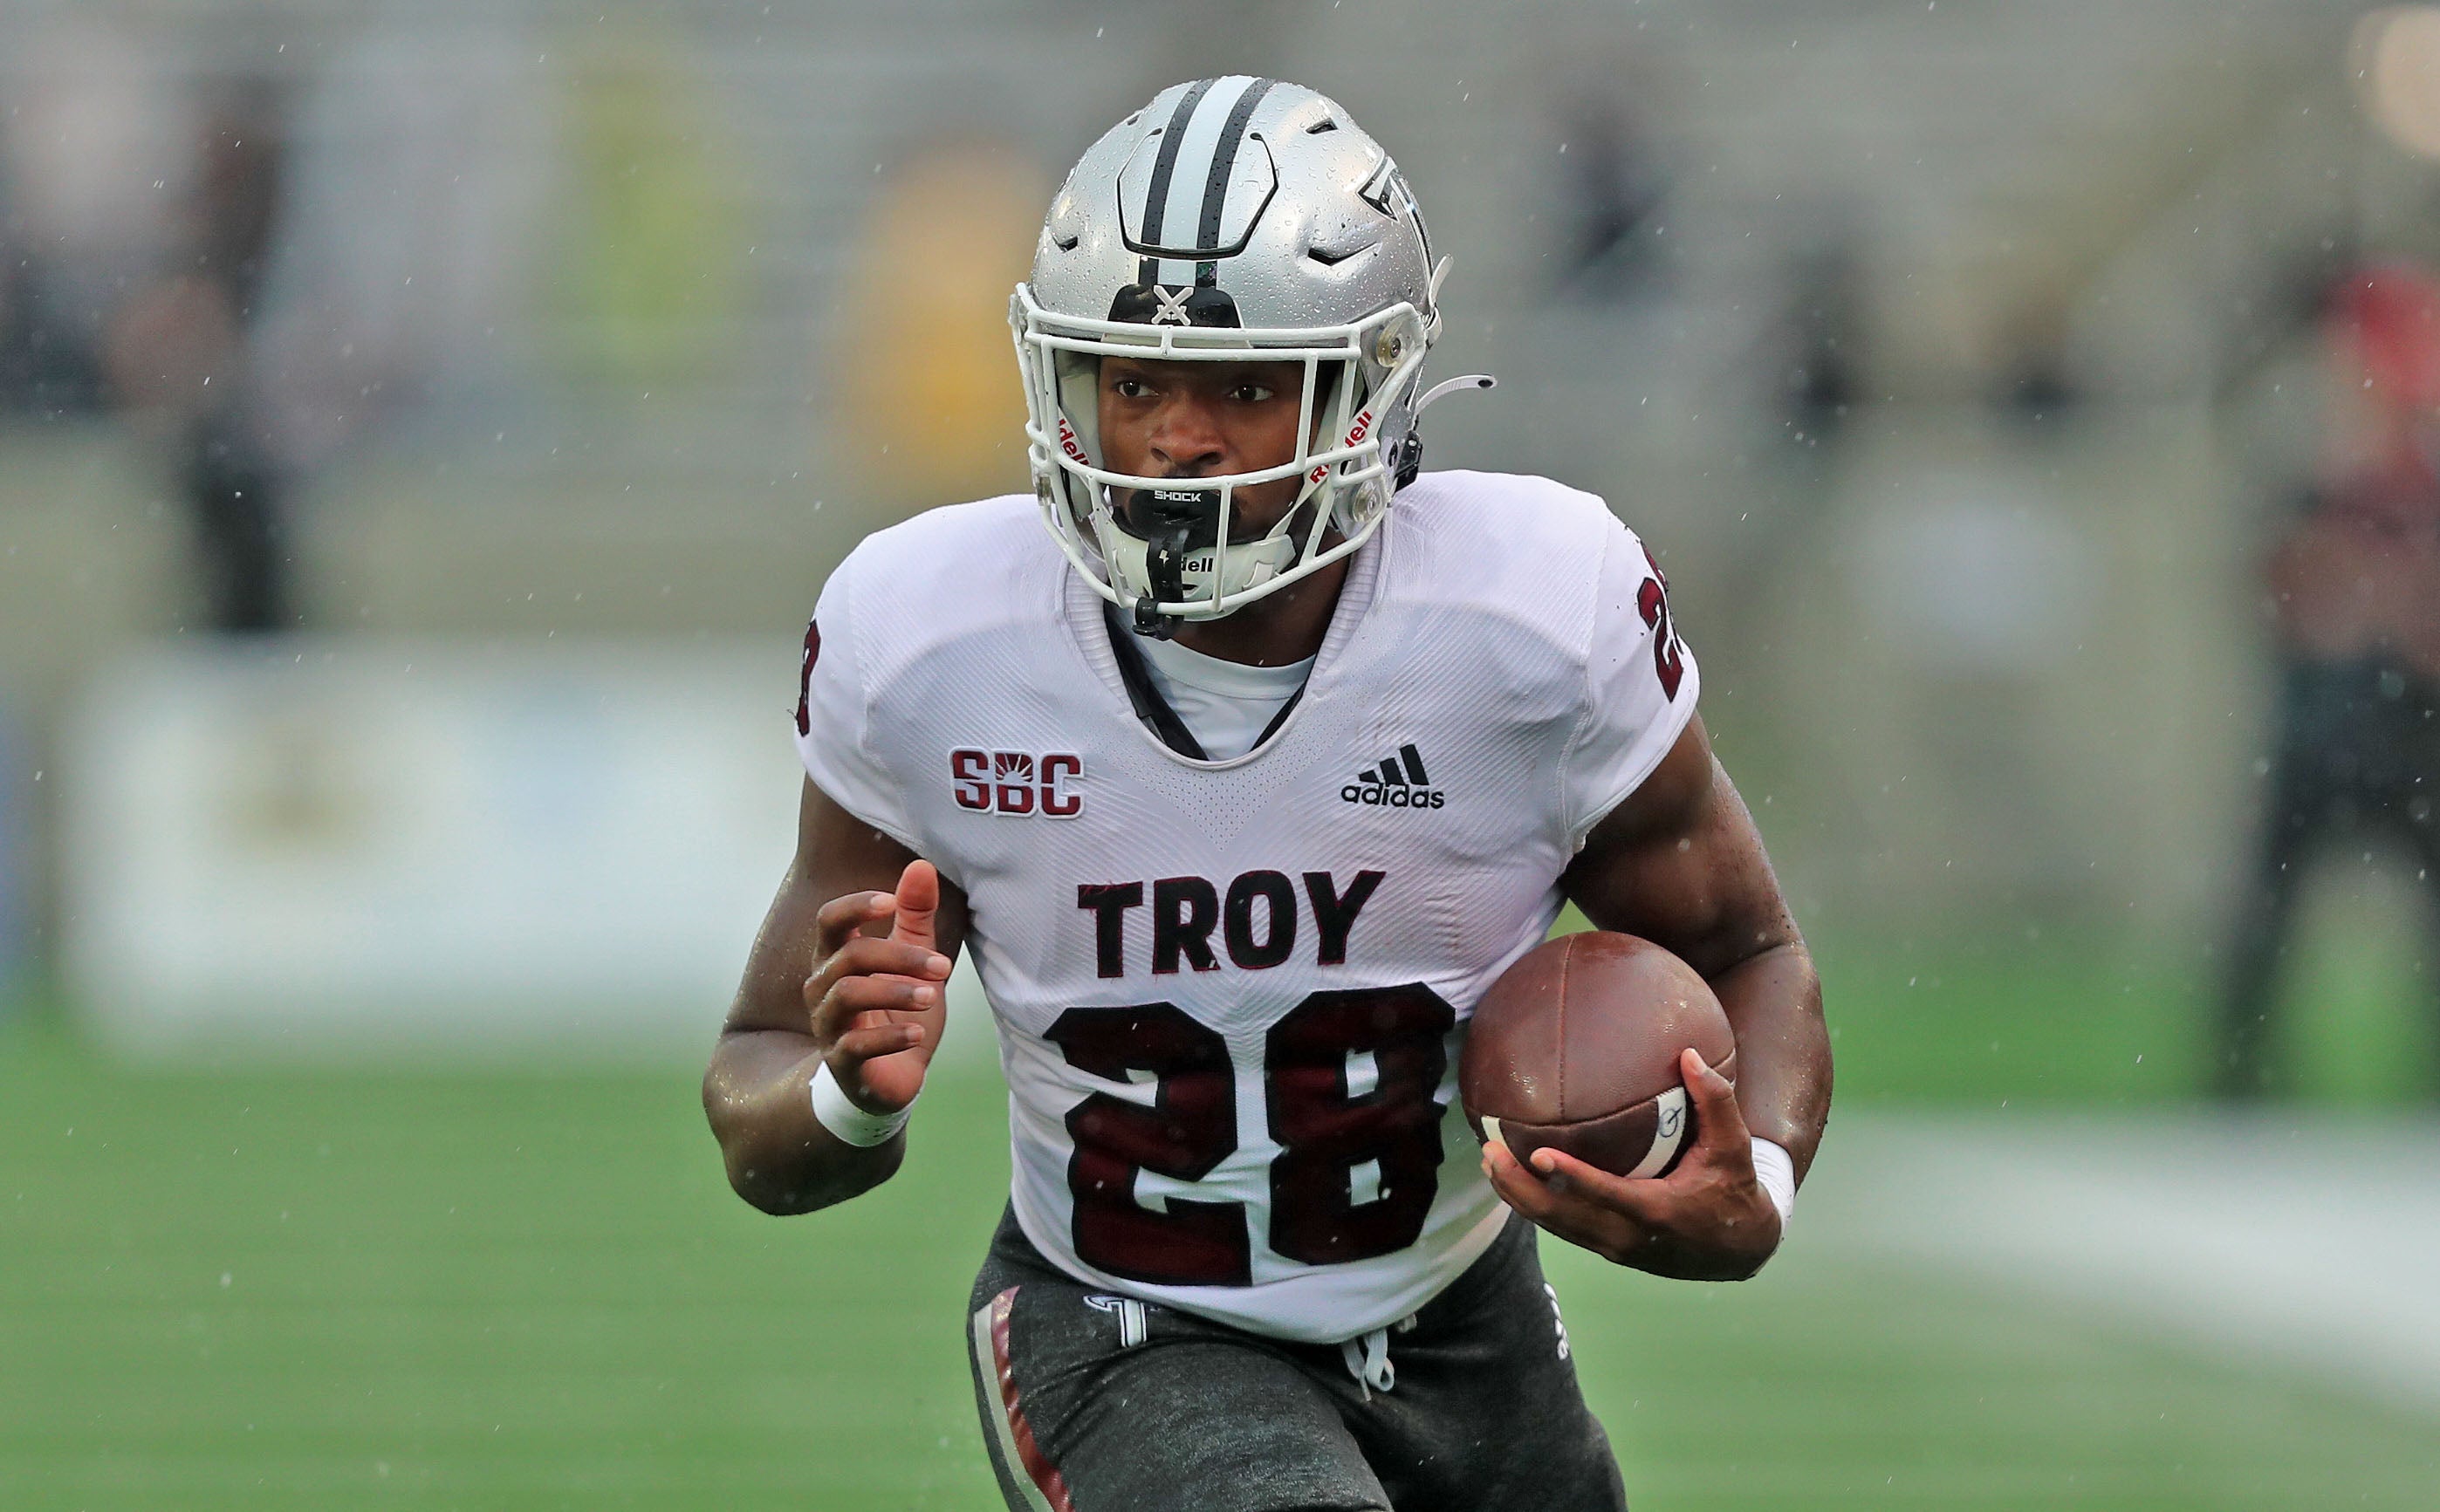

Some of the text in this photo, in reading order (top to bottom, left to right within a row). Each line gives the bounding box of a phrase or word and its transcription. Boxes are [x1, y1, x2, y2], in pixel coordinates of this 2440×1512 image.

[1154, 489, 1202, 503] SHOCK
[949, 746, 1085, 819] SBC
[1340, 782, 1445, 809] adidas
[1077, 869, 1386, 978] TROY
[1042, 982, 1456, 1287] 28
